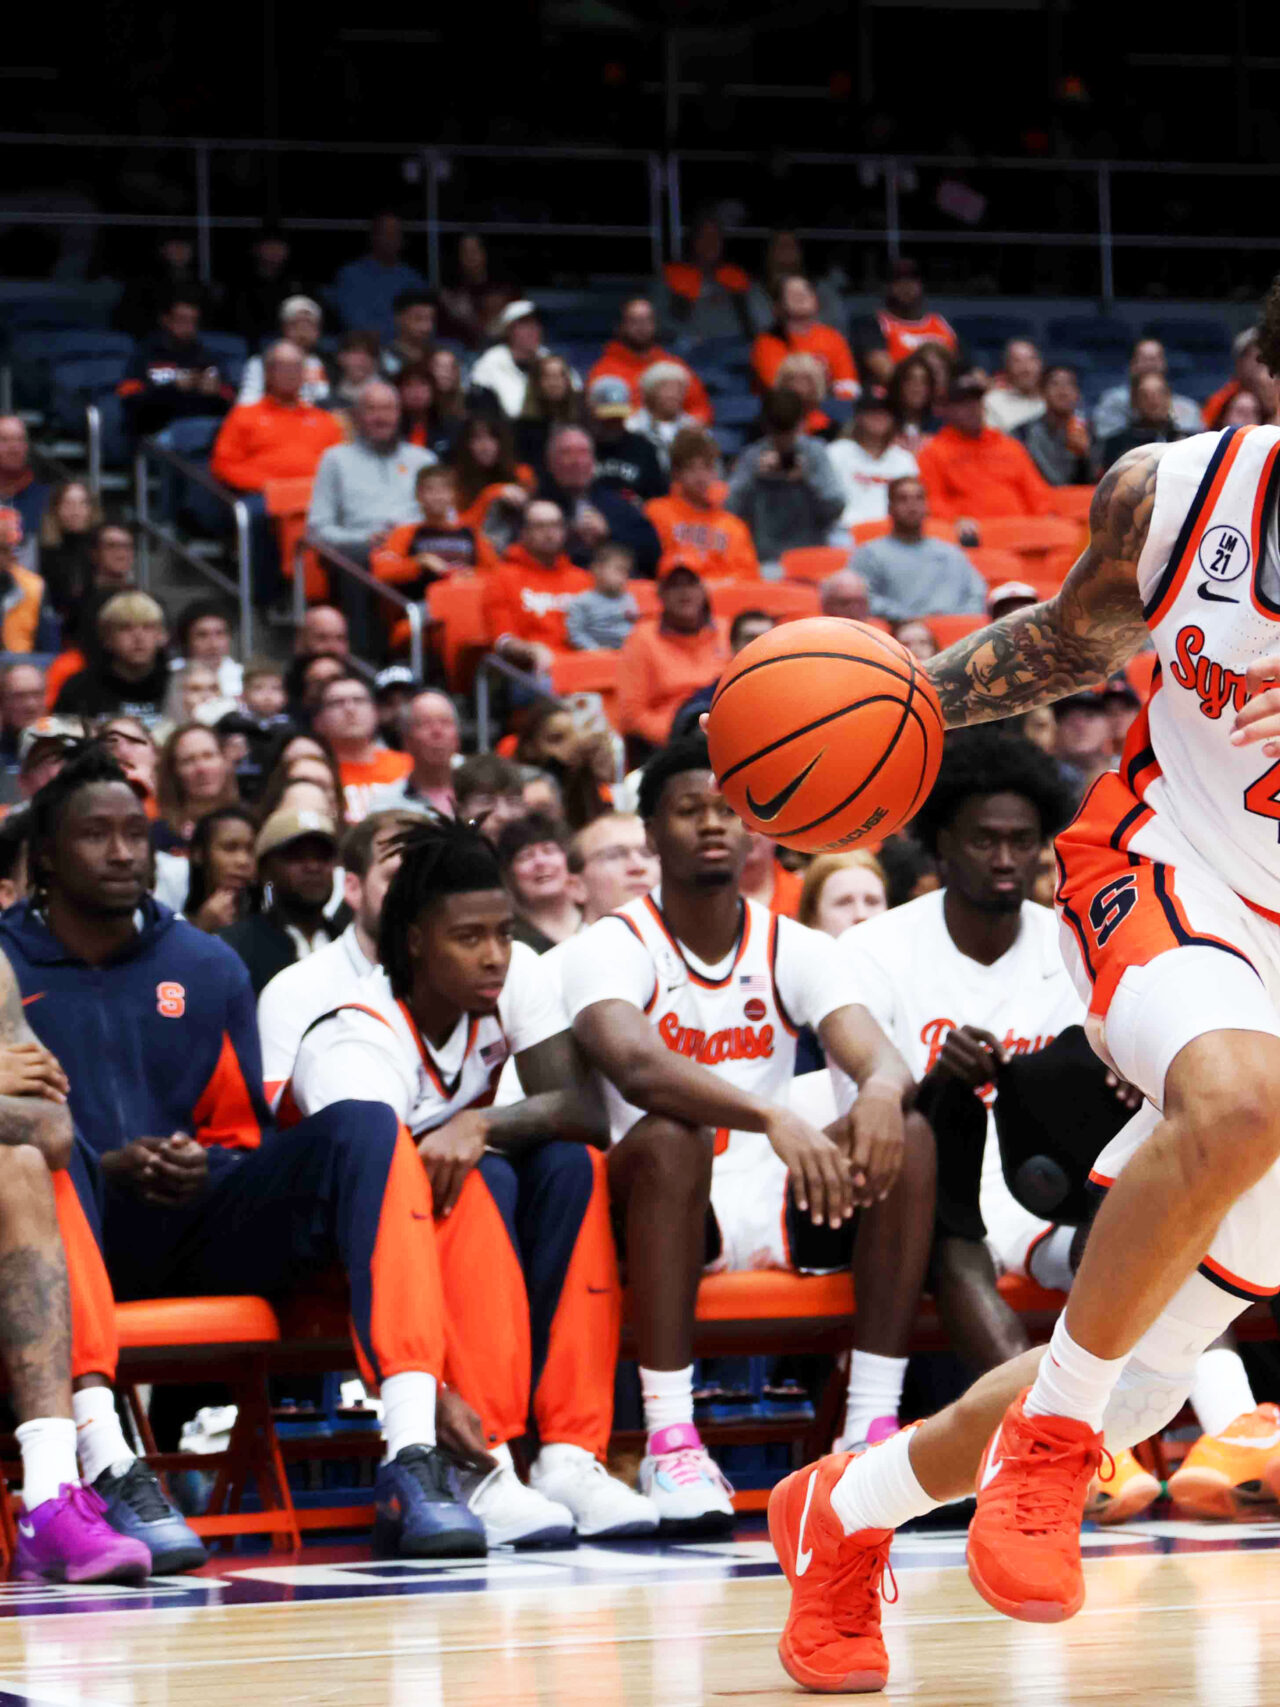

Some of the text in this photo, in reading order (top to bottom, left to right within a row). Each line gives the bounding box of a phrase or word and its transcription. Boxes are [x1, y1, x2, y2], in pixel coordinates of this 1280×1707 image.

[1219, 532, 1238, 553] LM
[1210, 548, 1231, 575] 21
[1088, 873, 1138, 950] S
[156, 981, 186, 1019] S
